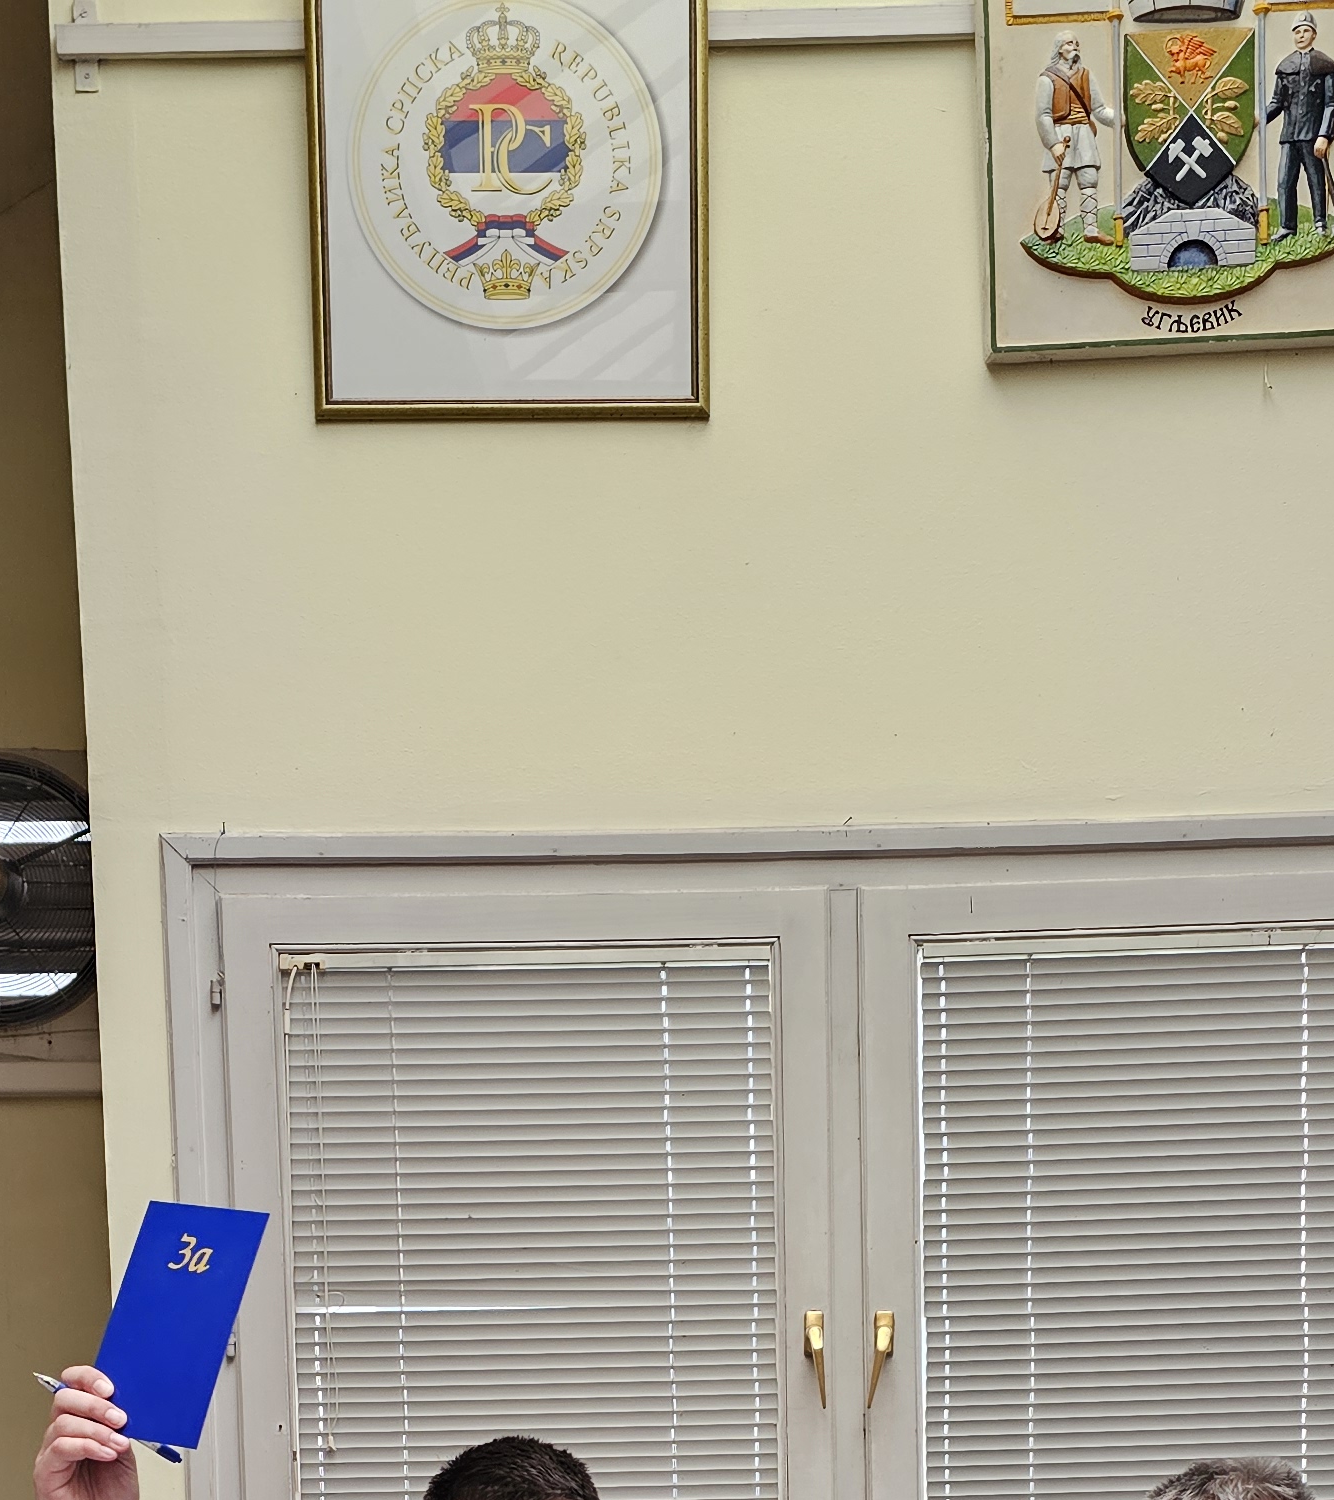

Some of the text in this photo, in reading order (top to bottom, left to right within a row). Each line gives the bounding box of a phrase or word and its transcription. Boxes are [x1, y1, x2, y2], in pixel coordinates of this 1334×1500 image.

[380, 40, 475, 290] РЕПУБЛИКА СРПСКА
[536, 38, 631, 290] REPUBLIKA SRPSKA
[1140, 299, 1243, 333] УГЉЕВИК
[167, 1232, 214, 1274] За
